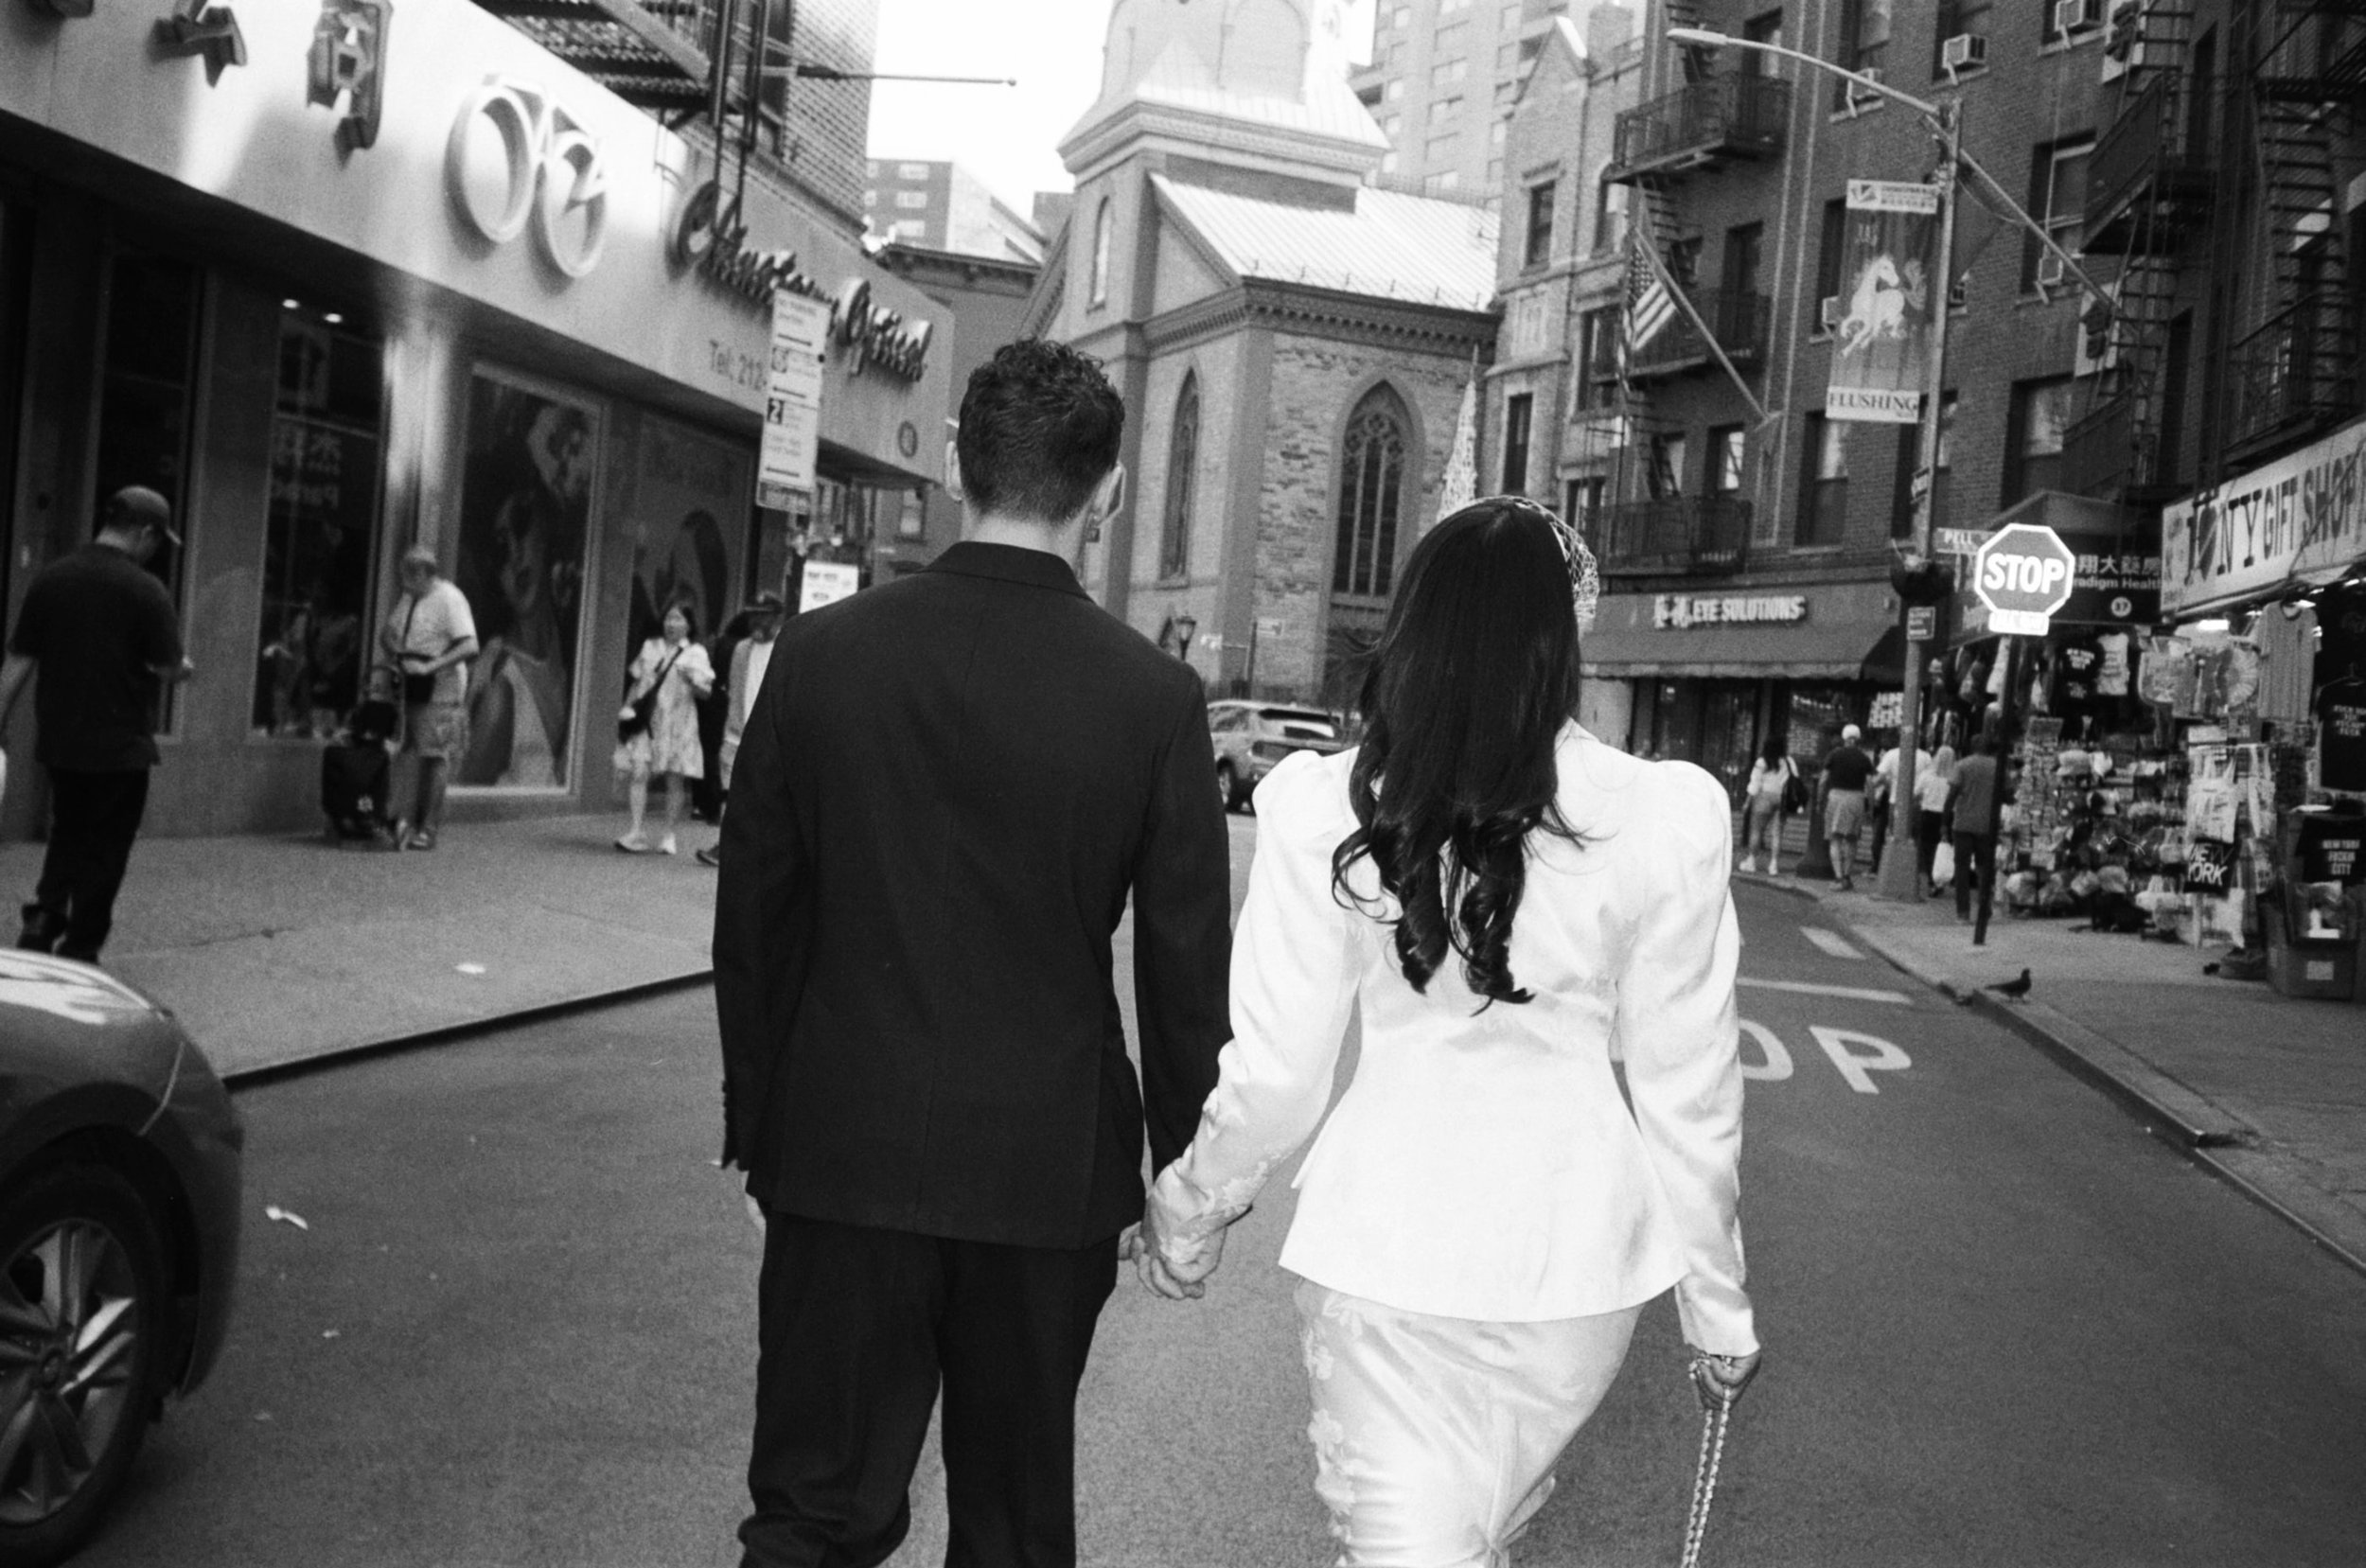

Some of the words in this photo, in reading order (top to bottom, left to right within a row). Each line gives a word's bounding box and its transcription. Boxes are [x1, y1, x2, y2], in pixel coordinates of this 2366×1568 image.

[1829, 392, 1918, 413] FLUSHING
[2264, 475, 2299, 560] GIFT
[2304, 452, 2357, 549] SHOP
[1943, 529, 1972, 546] PELL
[1984, 553, 2066, 594] STOP
[1693, 598, 1721, 623] EYE
[1722, 594, 1807, 622] SOLUTIONS
[2187, 861, 2228, 887] YORK
[1739, 1018, 1913, 1095] OP
